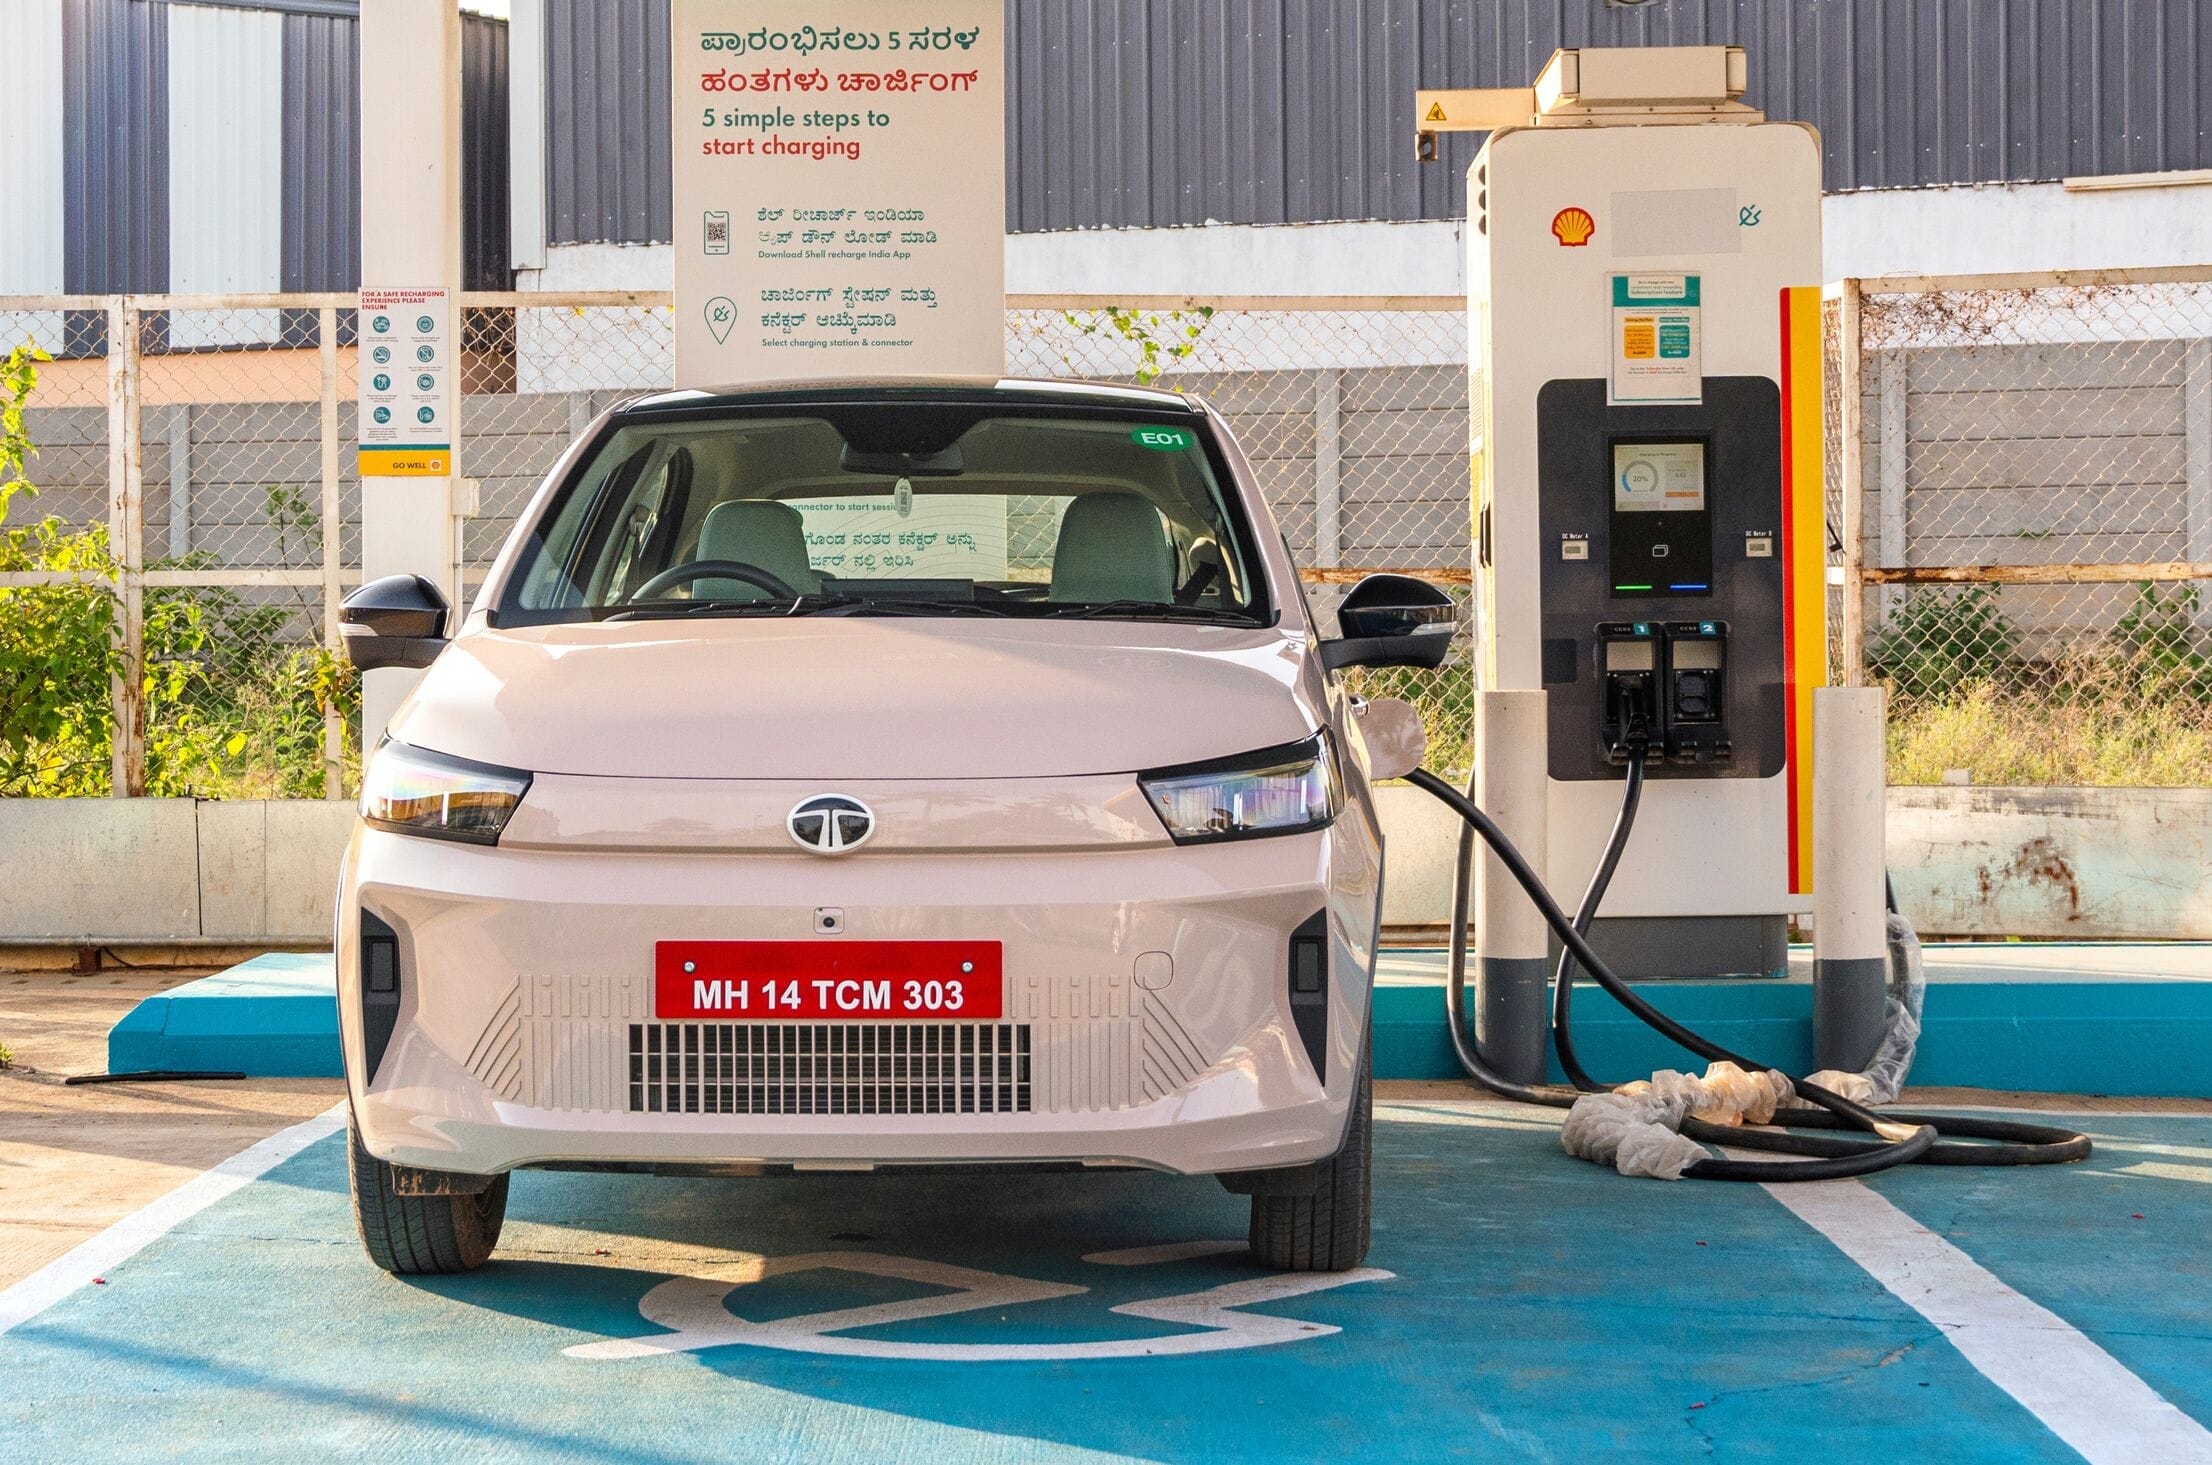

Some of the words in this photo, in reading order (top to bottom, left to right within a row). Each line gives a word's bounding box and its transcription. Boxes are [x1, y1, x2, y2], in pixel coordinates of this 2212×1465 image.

[700, 25, 880, 56] ಪ್ರಾರಂಭಿಸಲು
[888, 31, 900, 51] 5
[909, 26, 980, 52] ಸರಳ
[701, 68, 829, 92] ಹಂತಗಳು
[838, 69, 978, 94] ಚಾರ್ಜಿಂಗ್
[702, 109, 715, 127] 5
[724, 106, 795, 132] simple
[802, 110, 860, 132] steps
[868, 110, 890, 127] to
[702, 137, 754, 156] start
[762, 135, 860, 160] charging
[901, 230, 937, 244] ಮಾಡಿ
[758, 250, 802, 258] Download
[805, 250, 826, 258] Shell
[828, 250, 866, 260] recharge
[868, 250, 890, 258] India
[892, 250, 911, 260] App
[900, 287, 938, 308] ಮತ್ತು
[762, 312, 806, 334] ಕನೆಕ್ಟರ್
[762, 338, 788, 347] Select
[790, 338, 828, 348] charging
[830, 338, 859, 346] station
[862, 338, 868, 346] &
[871, 338, 913, 346] connector
[853, 532, 890, 545] ನಂತರ
[692, 980, 748, 1010] MH
[761, 980, 801, 1010] 14
[812, 980, 891, 1010] TCM
[904, 980, 964, 1010] 303
